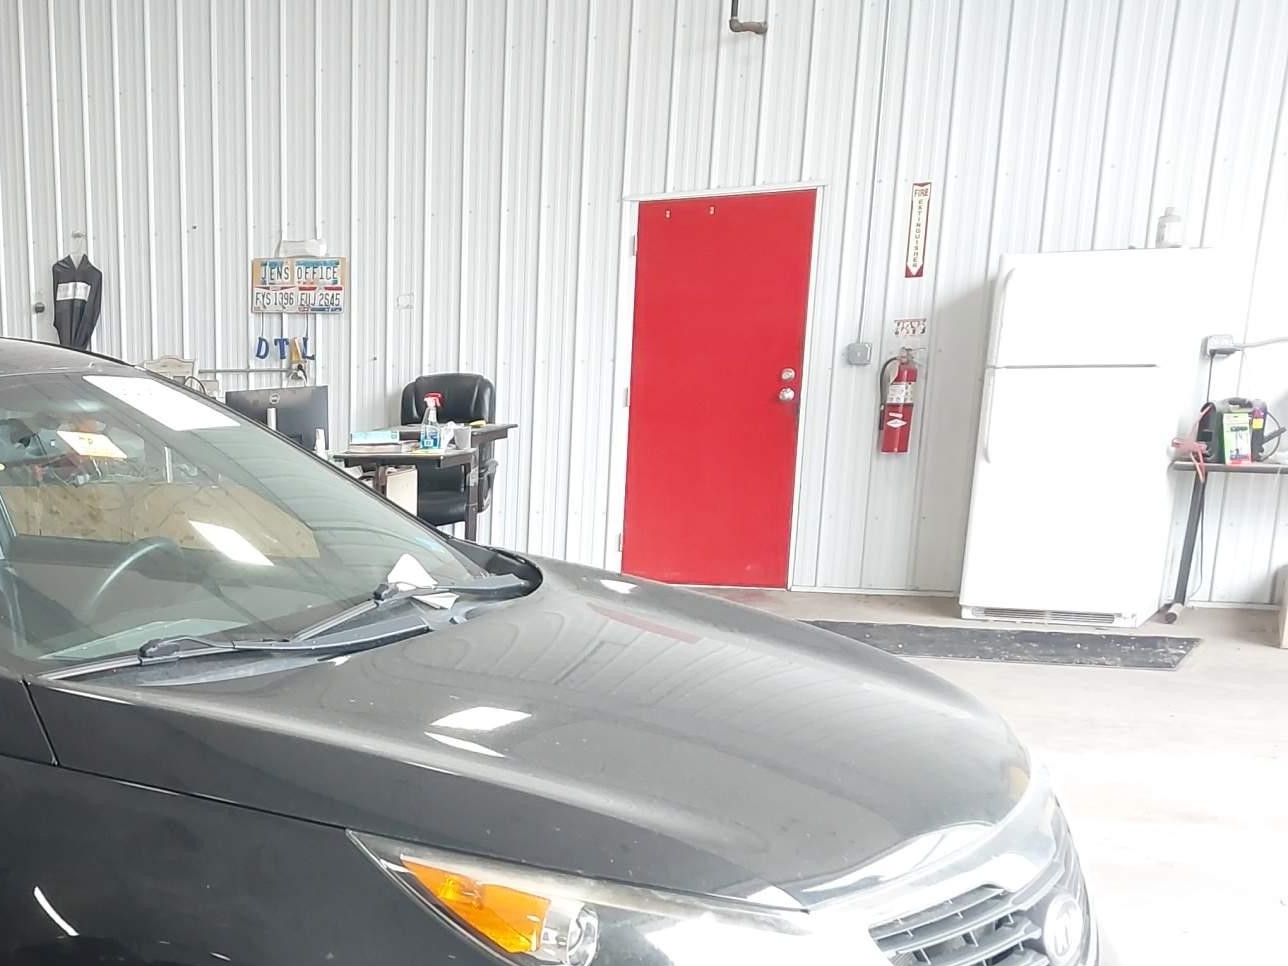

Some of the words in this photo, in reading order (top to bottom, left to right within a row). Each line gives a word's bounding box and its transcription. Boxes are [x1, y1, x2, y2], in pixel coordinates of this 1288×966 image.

[914, 188, 929, 197] FIRE
[912, 199, 924, 268] EXTINGUISHER
[261, 266, 290, 281] JENS
[296, 266, 339, 281] OFFICE
[255, 292, 272, 306] FYS
